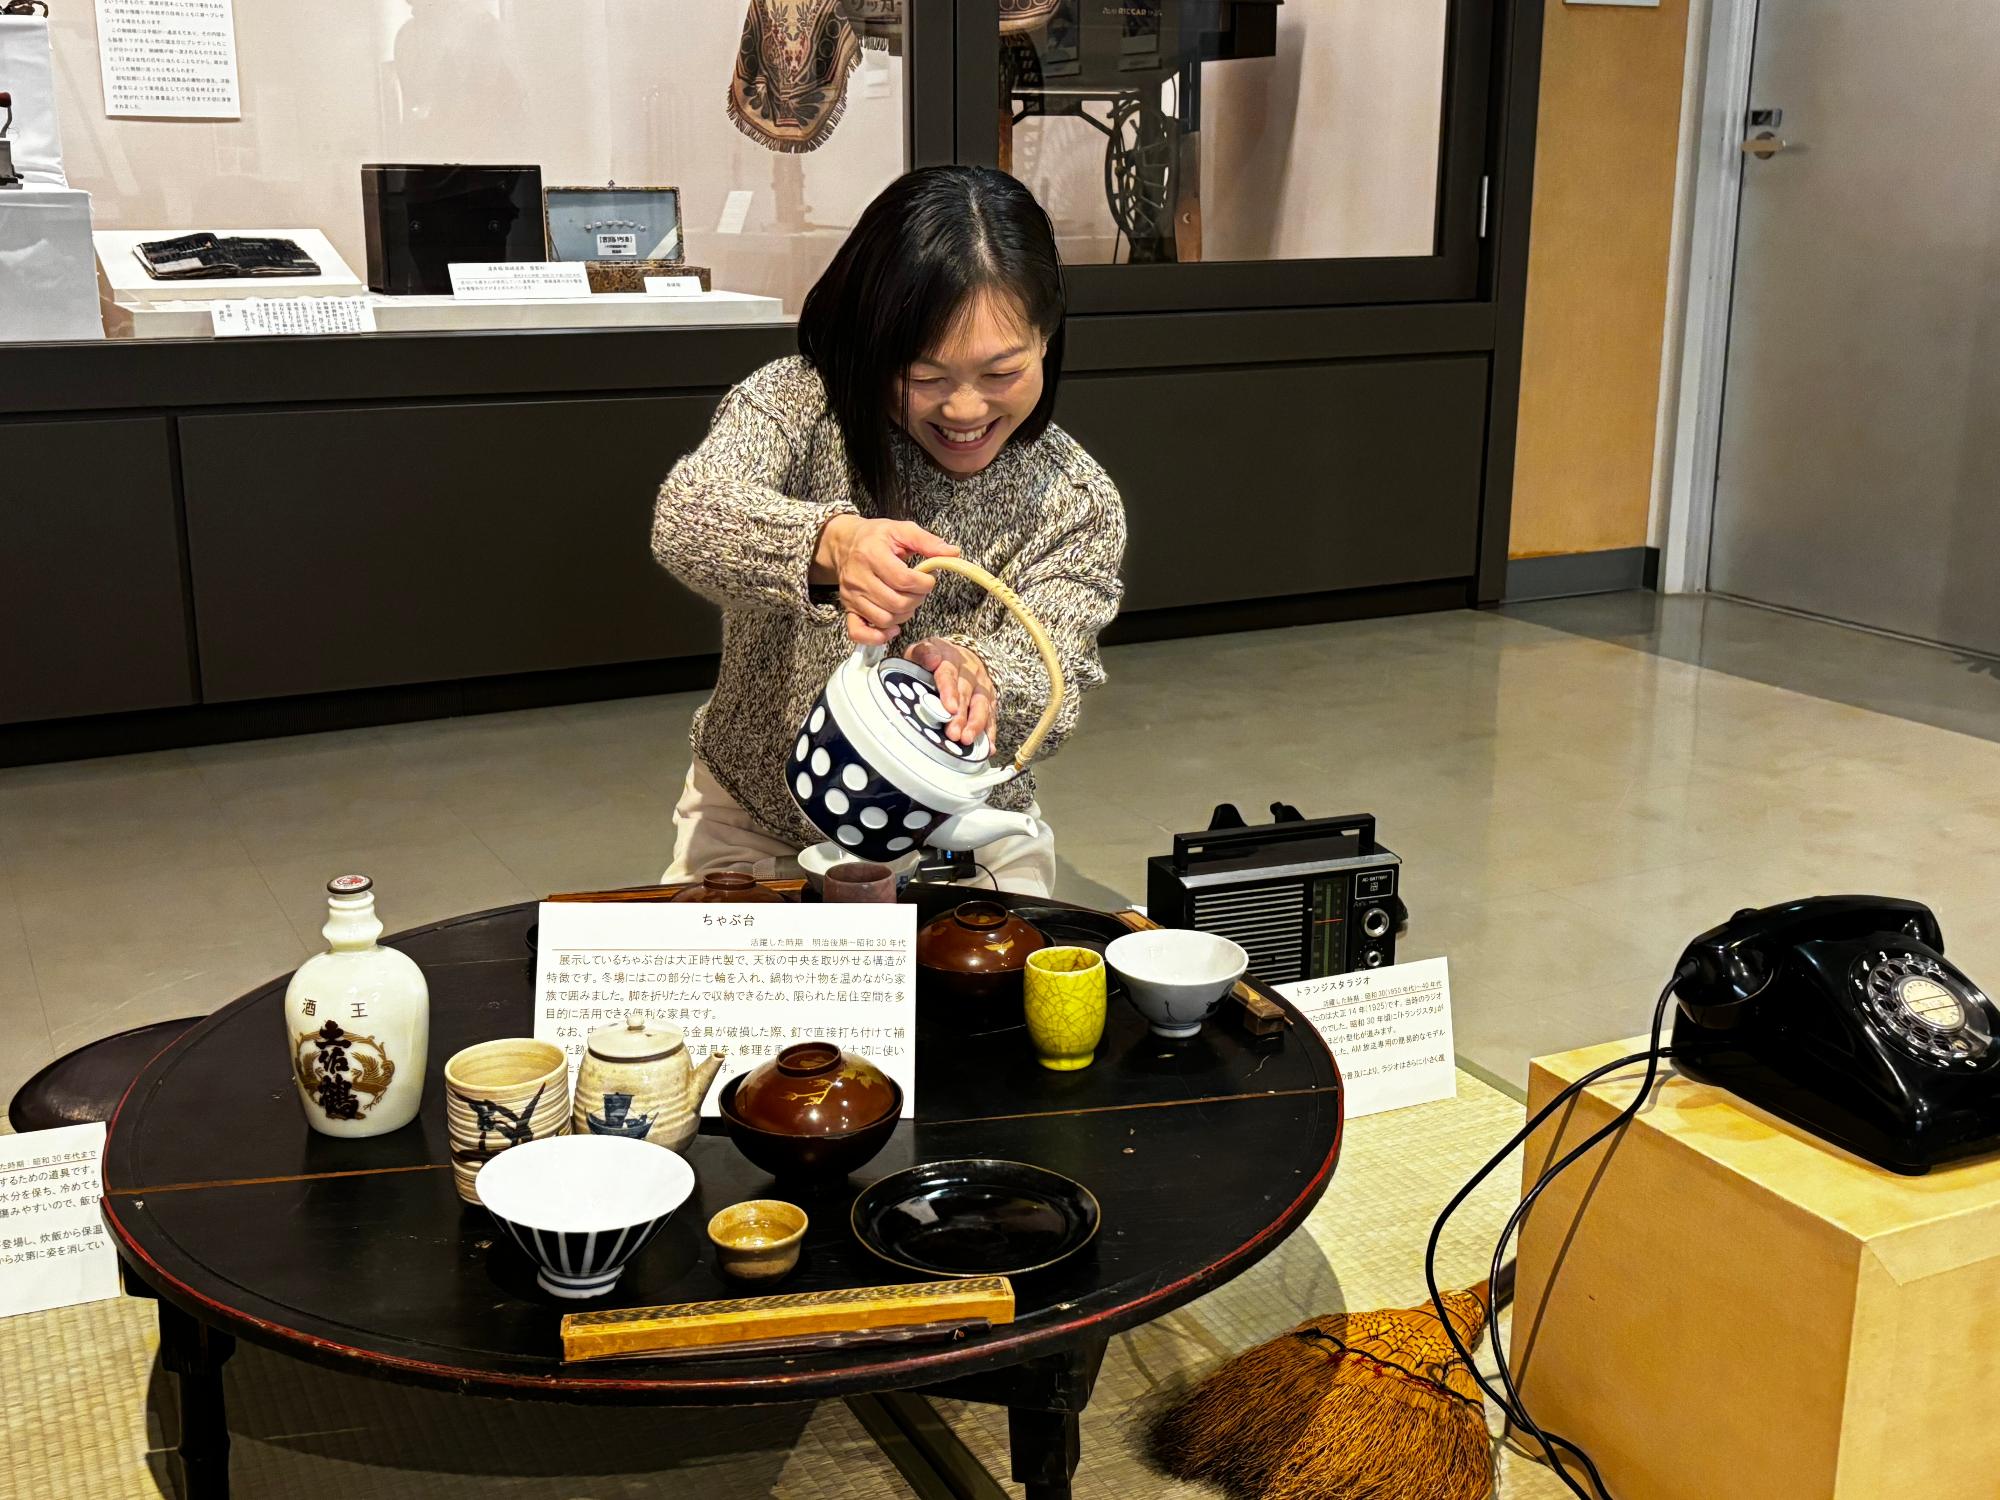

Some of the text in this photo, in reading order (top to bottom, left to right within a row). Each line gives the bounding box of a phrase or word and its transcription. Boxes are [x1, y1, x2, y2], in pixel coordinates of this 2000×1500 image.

[702, 913, 755, 927] ちゃぶ台
[559, 954, 906, 967] 展示しているちゃぶ台は大正時代製で、天板の中央を取り外せる構造が
[546, 972, 906, 984] 特徴です。冬場にはこの部分に七輪を入れ、鍋物や汁物を温めながら家
[1296, 976, 1372, 997] トランジスタラジオ
[545, 990, 905, 1002] 族で囲みました。脚を折りたたんで収納できるため、限られた居住空間を多
[302, 998, 368, 1018] 酒 王
[546, 1008, 717, 1020] 目的に活用できる便利な家具です。
[1332, 1029, 1446, 1057] した。AM放送専用の簡易的なモデル
[0, 1224, 103, 1249] 登場し、炊飯から保温
